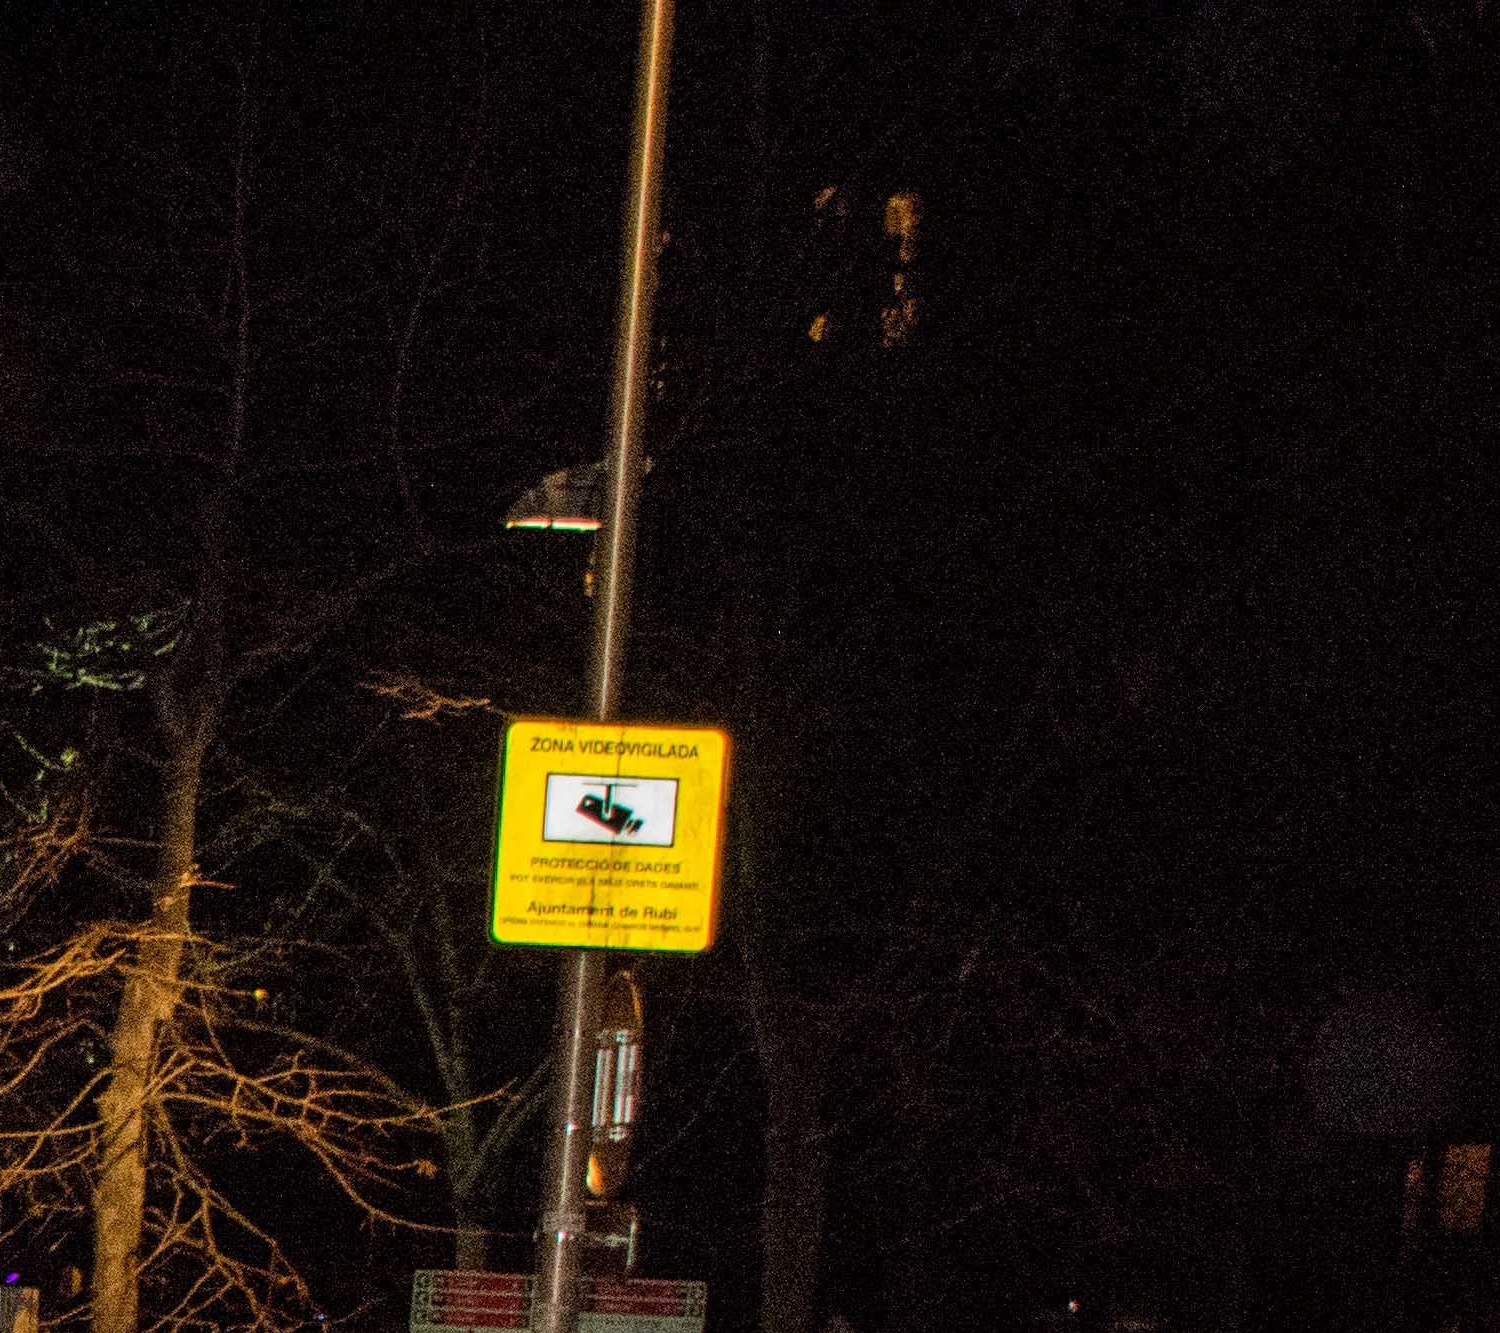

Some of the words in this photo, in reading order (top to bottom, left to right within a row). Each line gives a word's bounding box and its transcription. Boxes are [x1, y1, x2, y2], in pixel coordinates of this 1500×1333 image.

[530, 738, 574, 753] ZONA
[579, 740, 699, 759] VIDEOVIGILADA
[527, 901, 614, 917] Ajuntament
[619, 905, 638, 917] de
